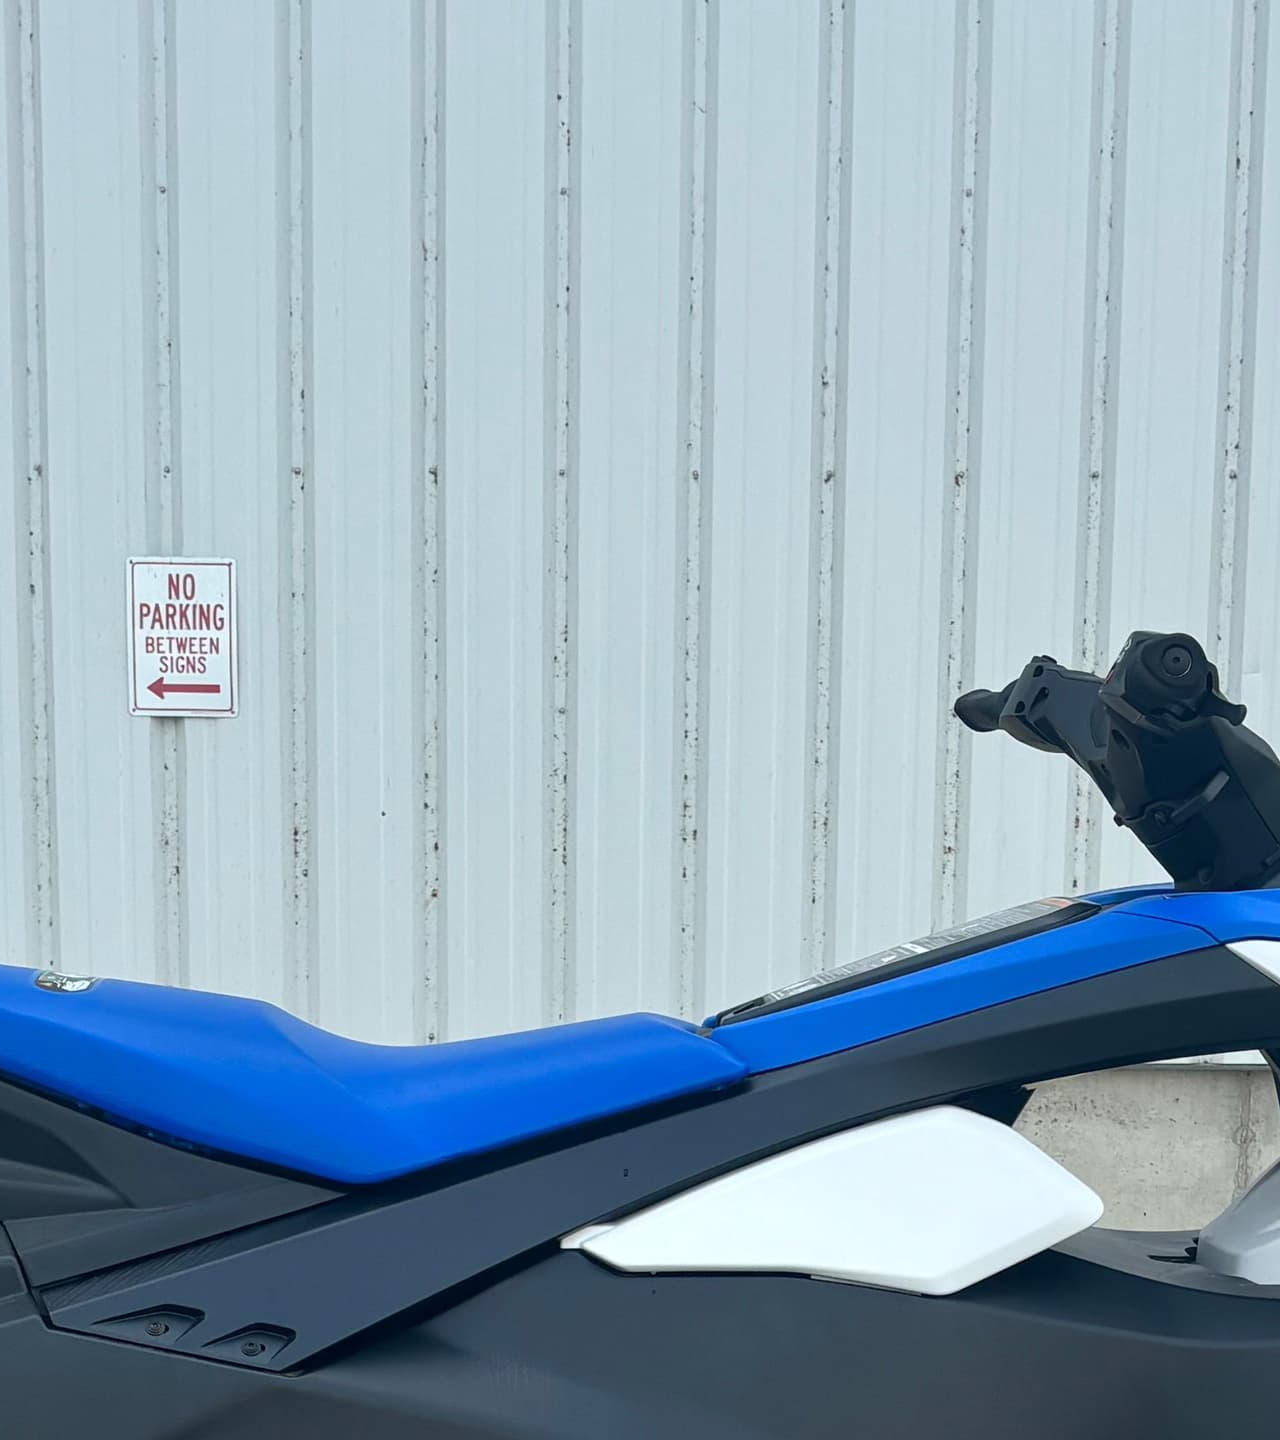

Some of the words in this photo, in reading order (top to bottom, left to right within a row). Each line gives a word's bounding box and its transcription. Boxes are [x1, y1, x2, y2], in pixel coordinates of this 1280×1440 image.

[168, 573, 196, 601] NO
[139, 603, 225, 631] PARKING
[145, 636, 220, 655] BETWEEN
[159, 656, 207, 674] SIGNS
